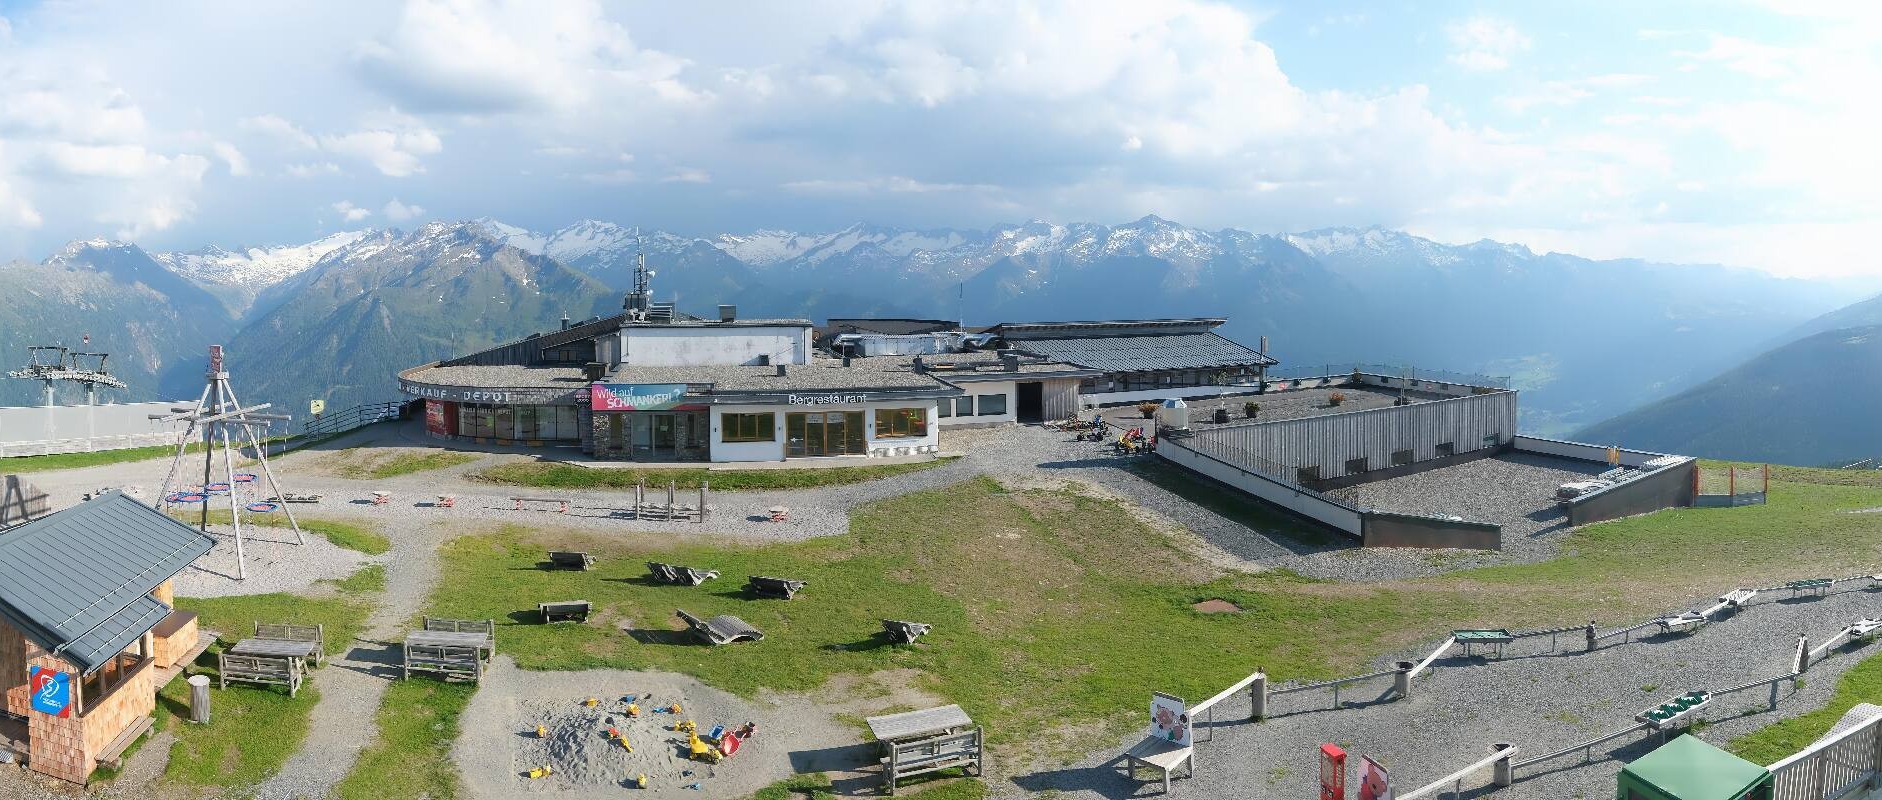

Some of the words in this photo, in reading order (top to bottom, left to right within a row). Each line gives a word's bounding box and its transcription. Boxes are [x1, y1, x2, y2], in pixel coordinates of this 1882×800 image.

[406, 384, 448, 399] VERKAUF
[463, 391, 512, 402] DEPOT
[596, 387, 617, 399] Wild
[618, 386, 634, 397] auf
[788, 394, 867, 406] Bergrestaurant
